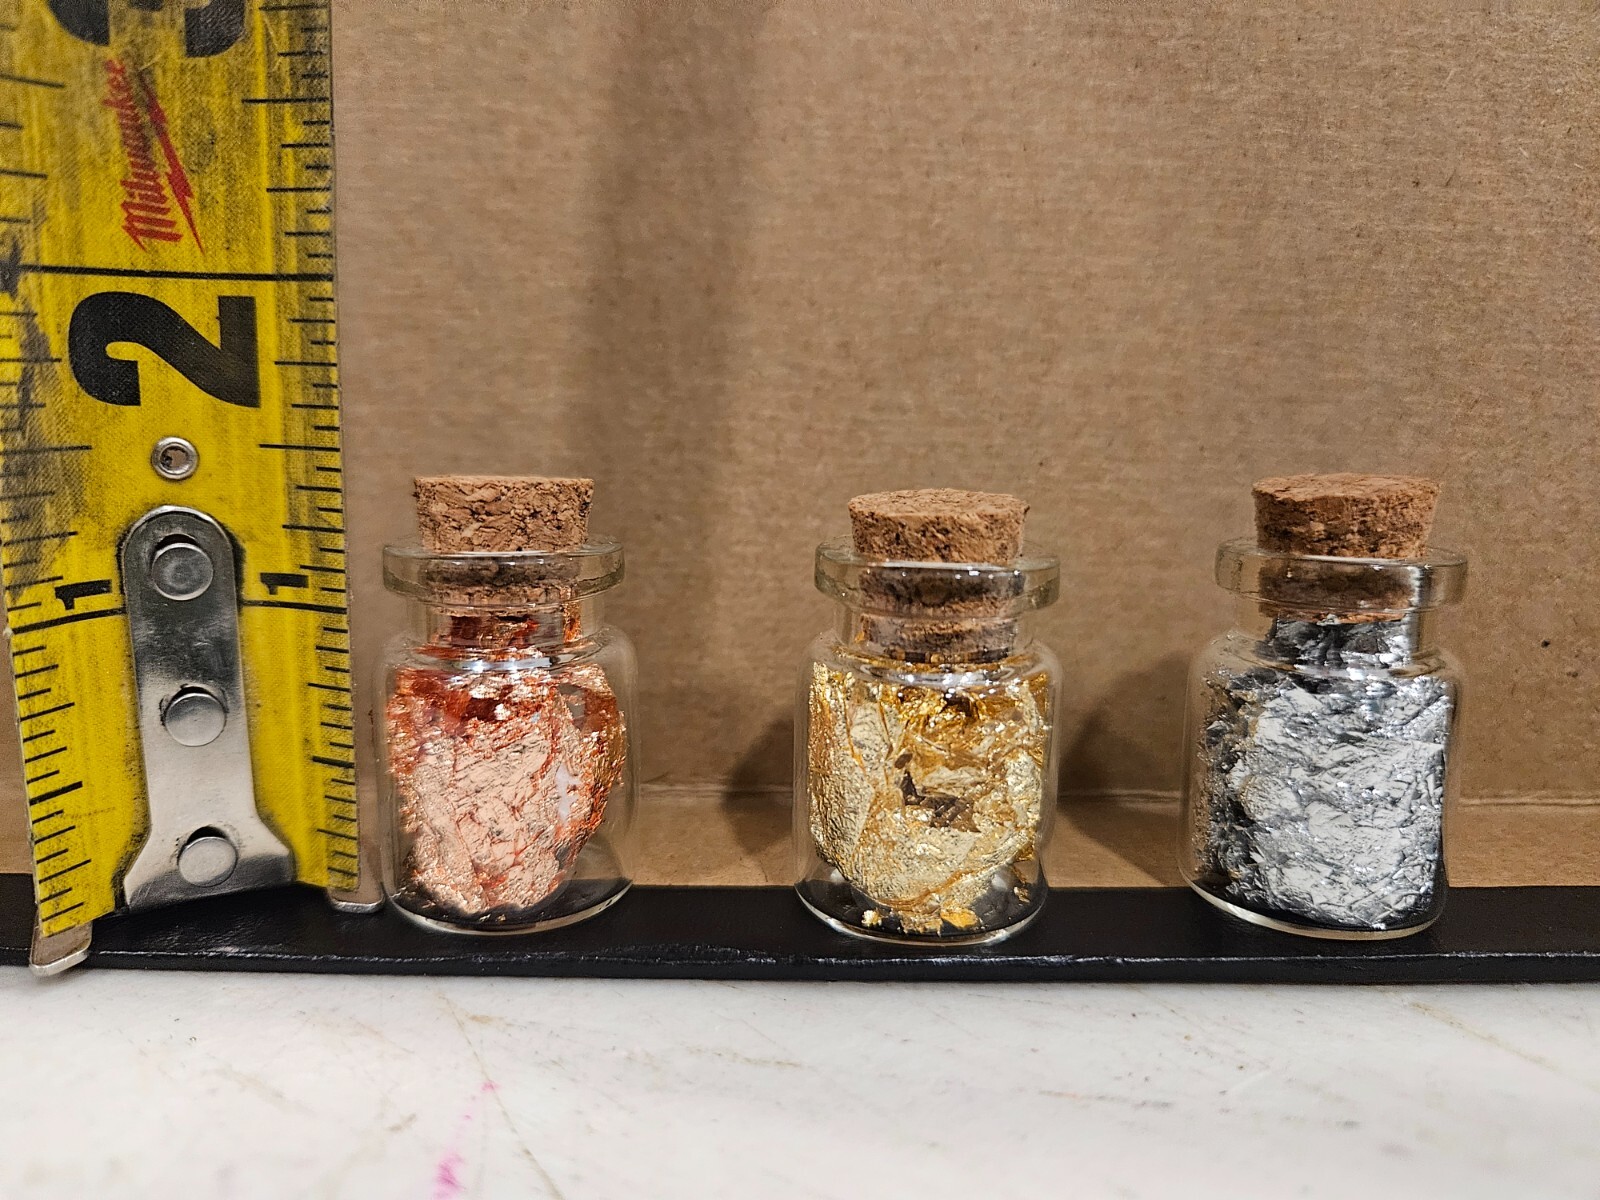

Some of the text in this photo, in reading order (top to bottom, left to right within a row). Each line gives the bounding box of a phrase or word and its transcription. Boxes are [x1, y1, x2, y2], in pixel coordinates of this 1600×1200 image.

[102, 58, 183, 252] Milwaukee
[68, 291, 261, 408] 2
[54, 579, 112, 610] 1
[260, 572, 309, 596] 1
